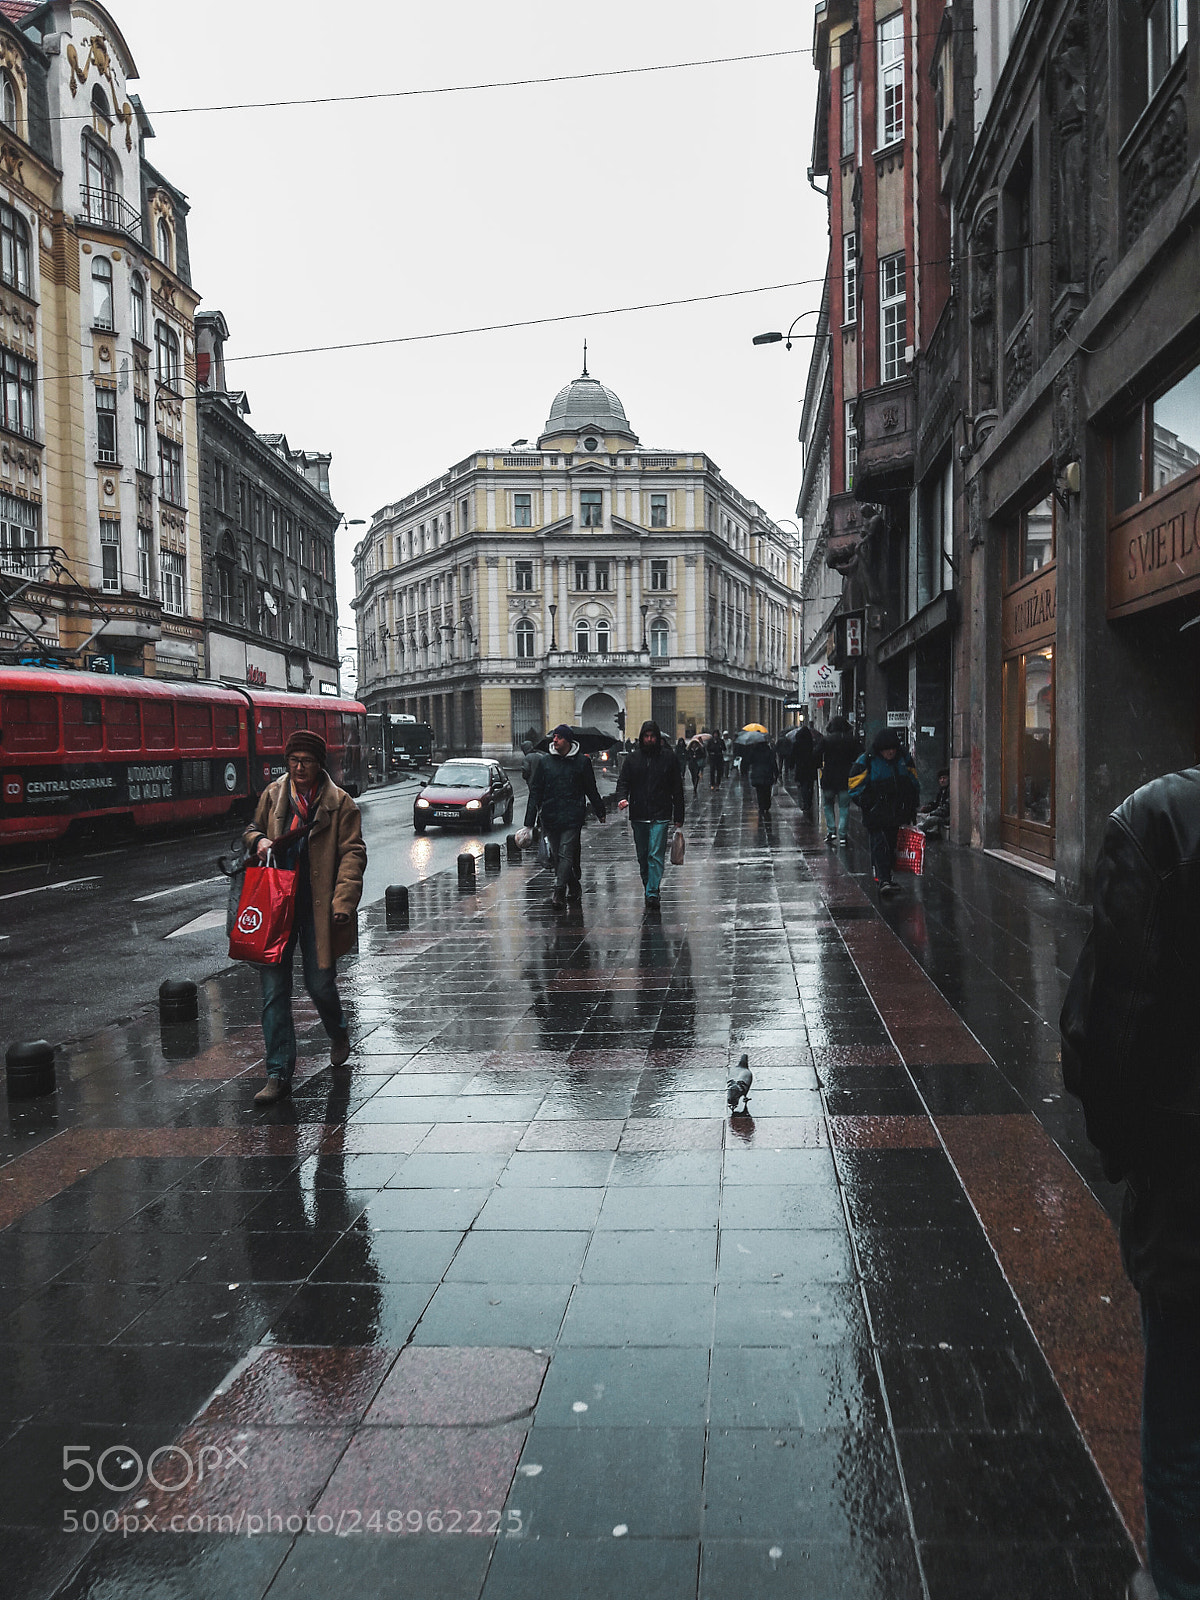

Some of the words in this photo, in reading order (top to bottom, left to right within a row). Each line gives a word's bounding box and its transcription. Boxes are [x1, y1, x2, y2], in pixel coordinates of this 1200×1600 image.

[26, 780, 68, 793] CENTRAL
[70, 777, 113, 790] OSIGURANJE
[242, 913, 257, 926] C&A
